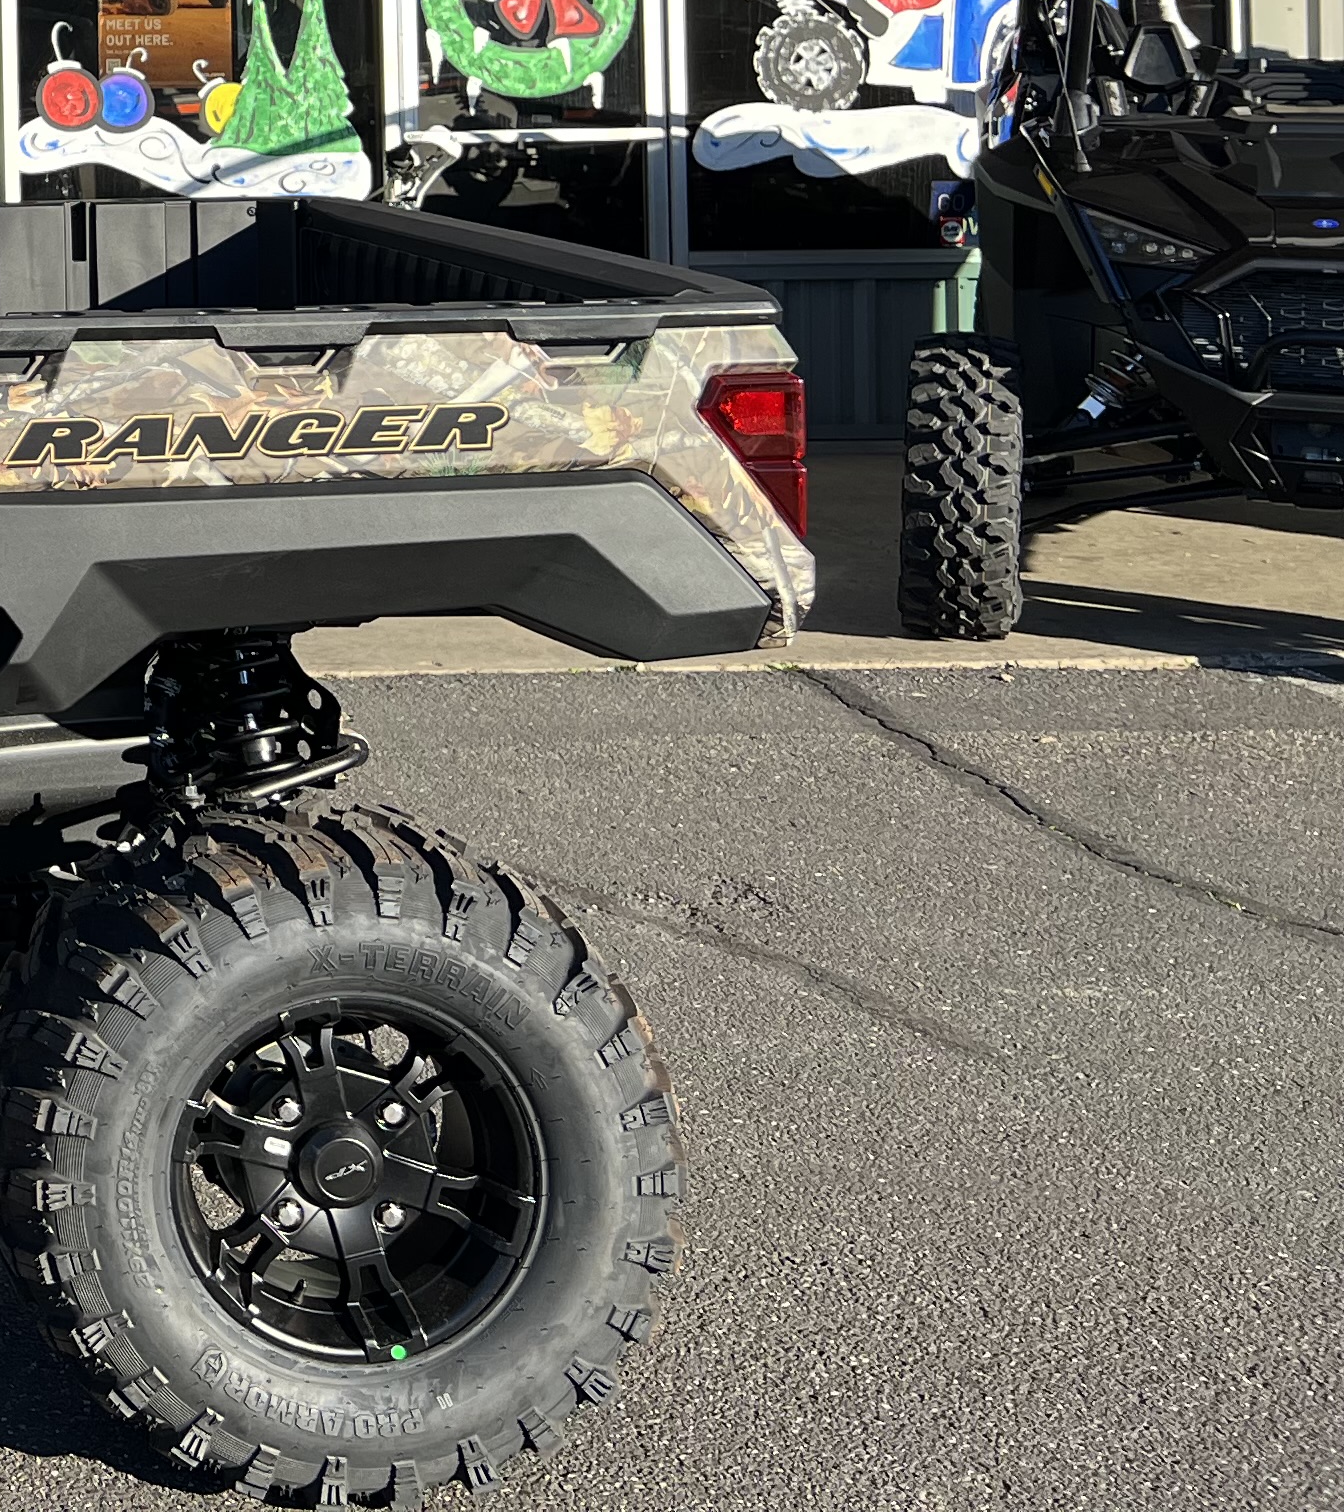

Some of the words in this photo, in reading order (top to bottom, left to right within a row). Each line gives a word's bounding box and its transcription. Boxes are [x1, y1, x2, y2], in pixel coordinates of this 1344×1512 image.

[106, 19, 141, 30] MEET
[144, 19, 162, 30] US
[106, 35, 132, 46] OUT
[135, 34, 174, 46] HERE.
[4, 401, 509, 468] RANGER
[307, 941, 532, 1029] X-TERRAIN
[222, 1371, 346, 1438] ARMOR
[353, 1407, 426, 1439] PRO
